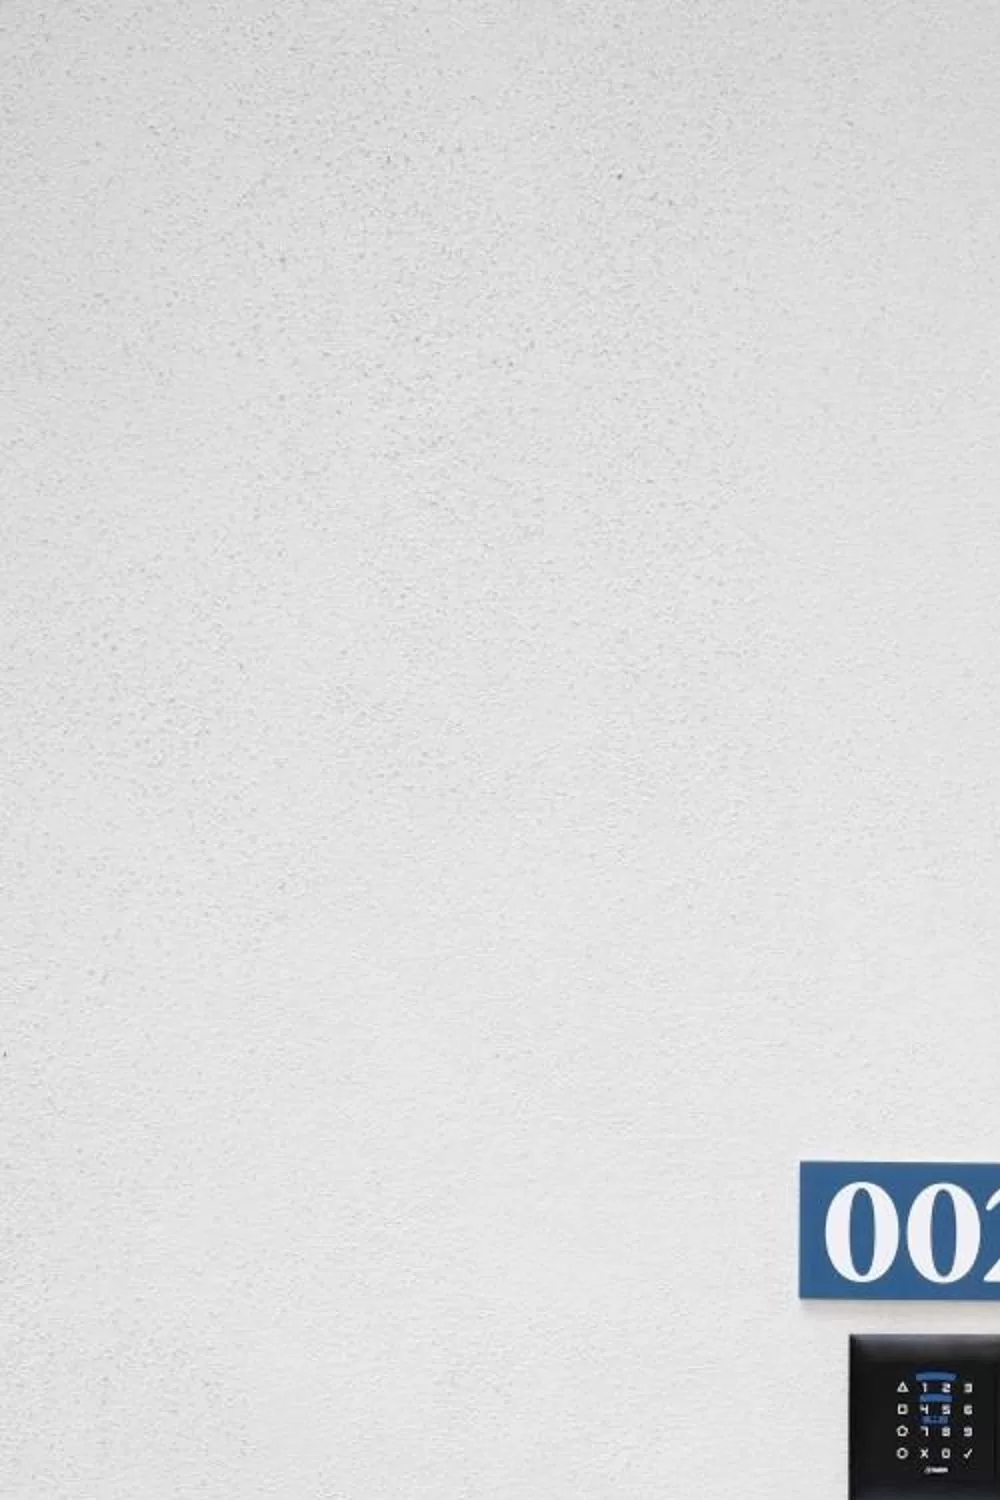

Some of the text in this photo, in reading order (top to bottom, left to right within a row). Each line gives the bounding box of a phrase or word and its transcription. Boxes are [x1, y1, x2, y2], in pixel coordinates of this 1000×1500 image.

[921, 1382, 973, 1394] 1 2 3
[919, 1403, 973, 1416] 4 5 6
[919, 1425, 973, 1437] 7 8 9
[941, 1447, 951, 1459] 0
